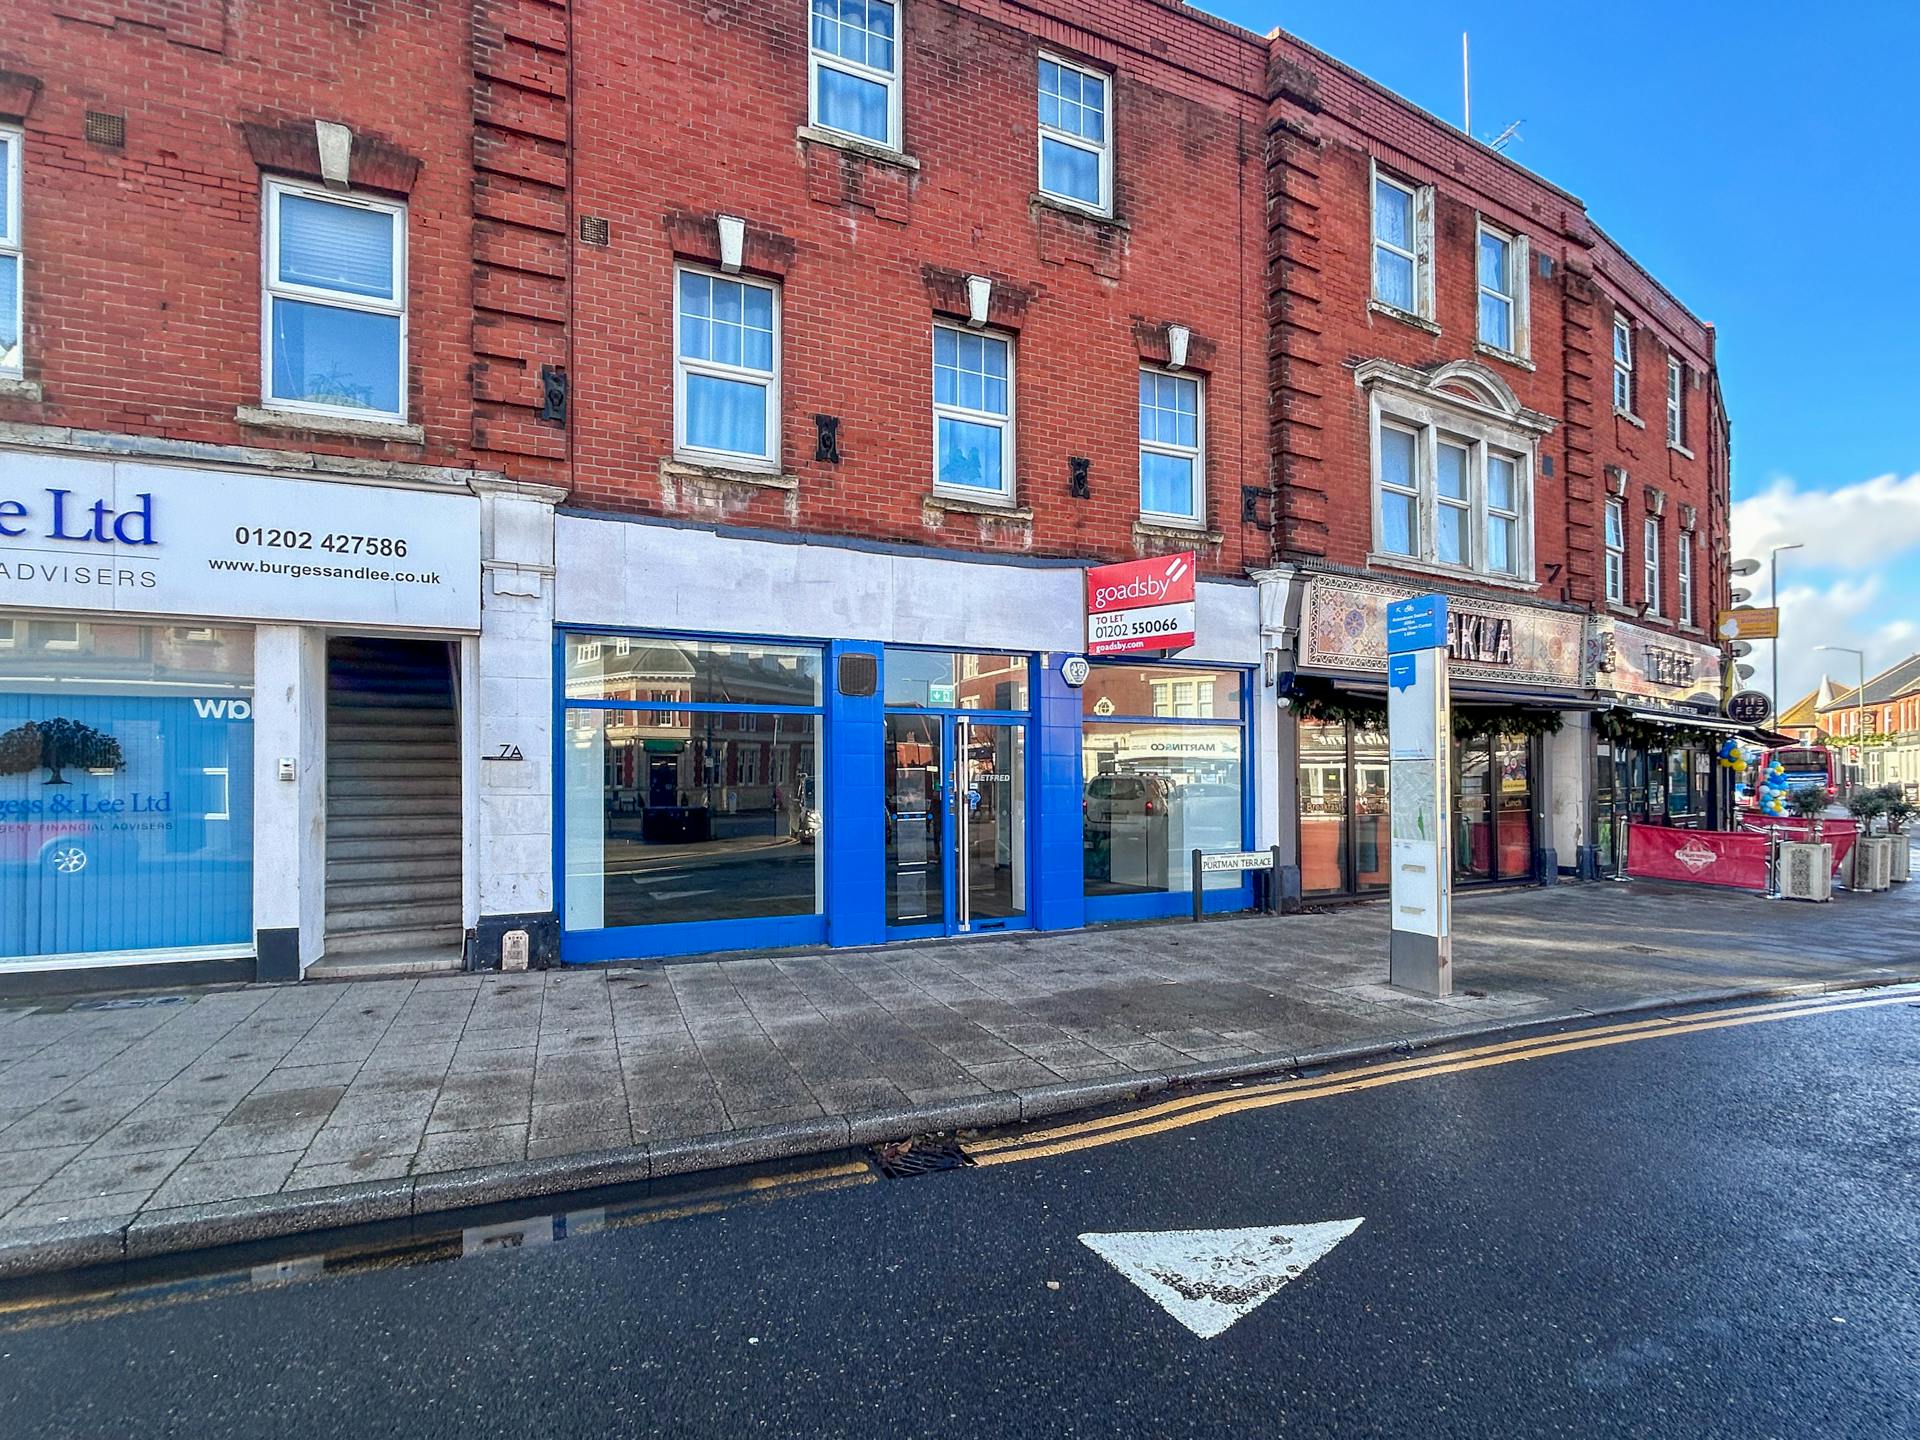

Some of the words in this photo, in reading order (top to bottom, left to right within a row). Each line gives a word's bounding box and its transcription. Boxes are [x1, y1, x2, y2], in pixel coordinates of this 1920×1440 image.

[45, 488, 159, 545] Ltd
[235, 526, 313, 550] 01202
[320, 533, 408, 557] 427586
[0, 562, 157, 588] ADVISERS
[208, 559, 441, 584] www.burgessandlee.co.uk
[1095, 574, 1170, 608] goadsby
[1096, 616, 1108, 624] TO
[1109, 614, 1124, 623] LET
[1095, 623, 1128, 638] 01202
[1132, 618, 1178, 635] 550066
[1095, 641, 1144, 654] goadsby.com
[1736, 706, 1765, 715] FEZ
[499, 744, 524, 758] 7A
[975, 774, 1010, 782] BETFRED
[81, 793, 125, 813] Lee
[132, 791, 172, 813] Ltd
[113, 821, 173, 831] ADVISERS
[1240, 857, 1272, 867] TERRACE
